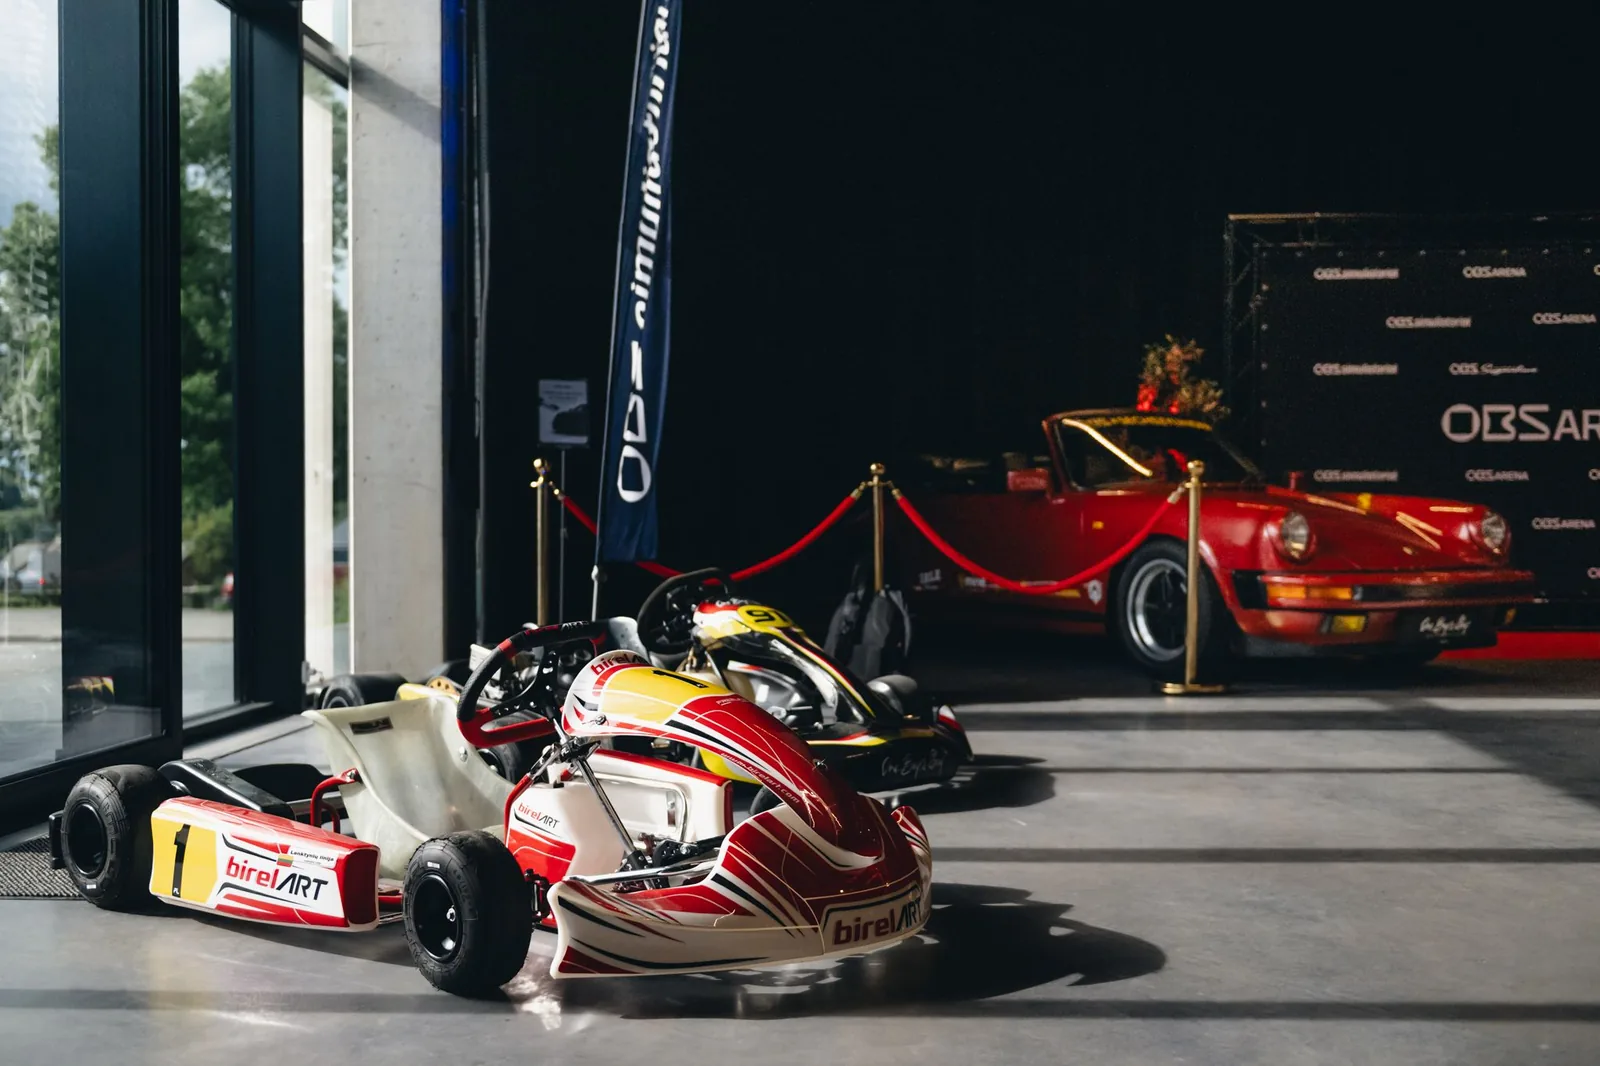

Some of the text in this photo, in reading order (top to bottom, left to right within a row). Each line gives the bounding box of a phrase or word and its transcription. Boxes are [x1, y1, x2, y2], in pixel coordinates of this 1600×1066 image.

[518, 802, 560, 829] birelART
[172, 823, 191, 898] 1
[225, 855, 329, 901] birelART
[834, 899, 921, 945] birelART
